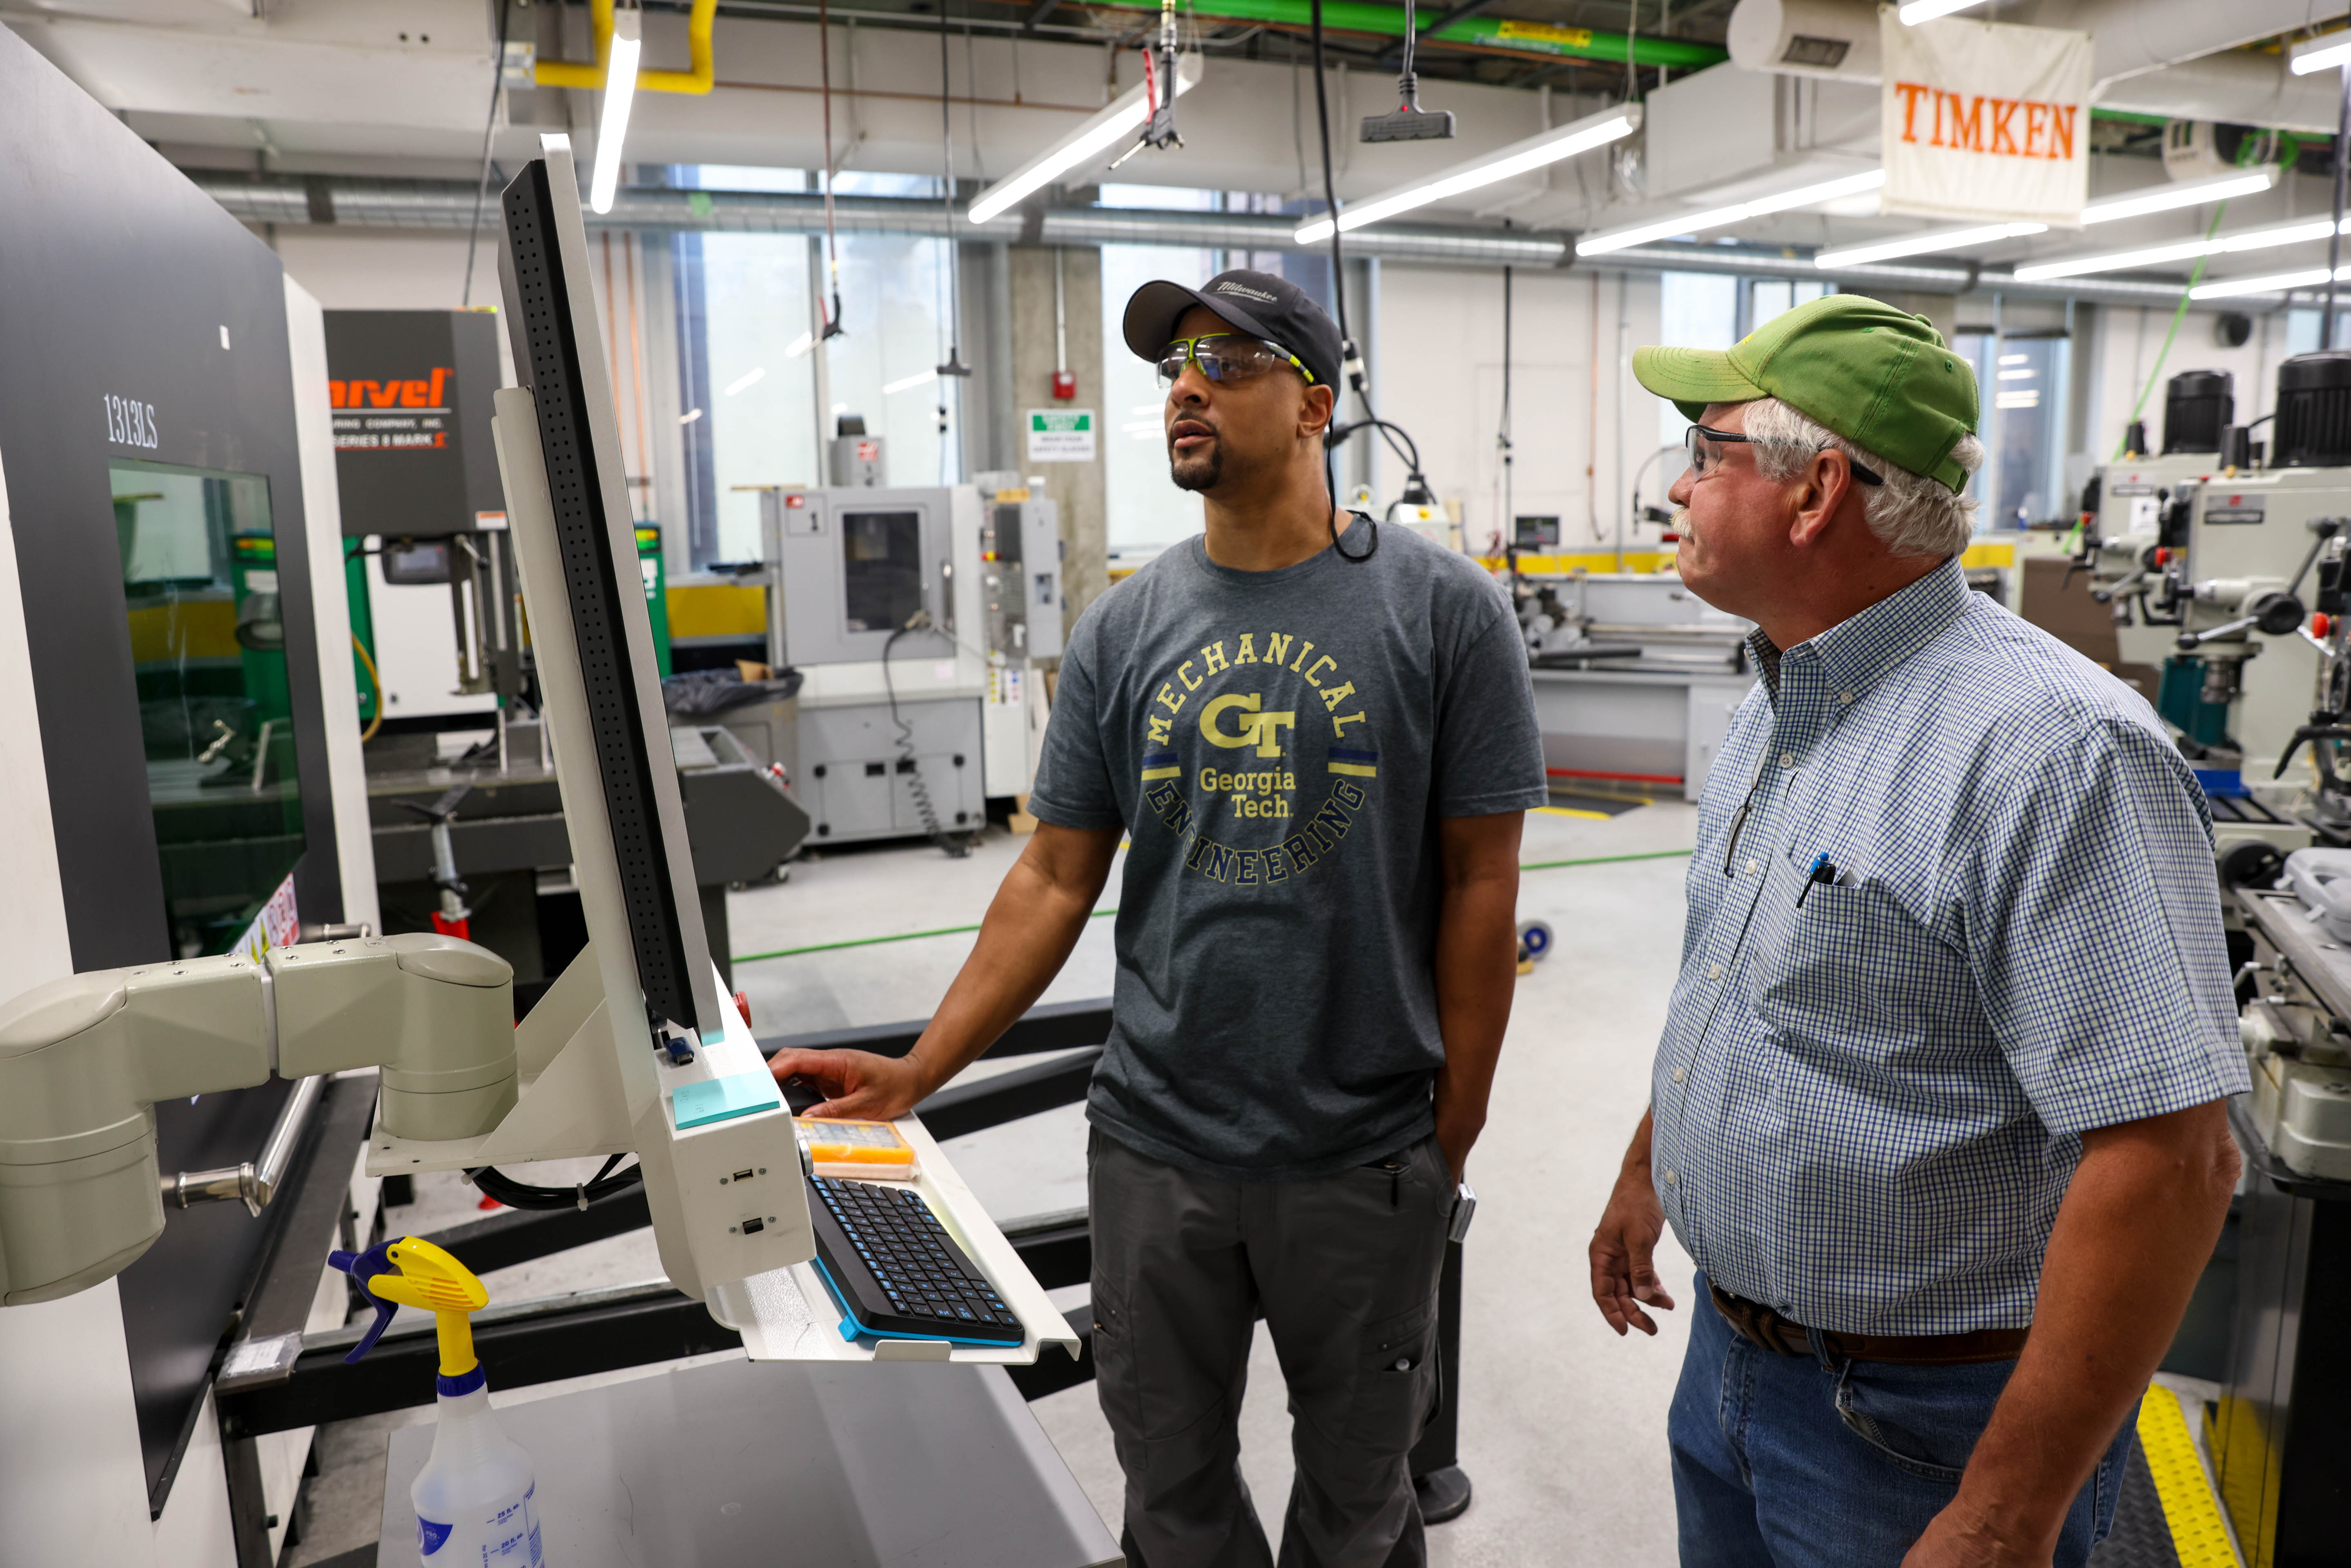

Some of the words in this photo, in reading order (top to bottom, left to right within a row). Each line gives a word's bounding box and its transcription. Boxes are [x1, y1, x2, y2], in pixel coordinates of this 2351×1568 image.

[1895, 81, 2077, 160] TIMKEN
[1217, 281, 1277, 302] Milwaukee
[104, 393, 158, 449] 1313LS
[392, 433, 433, 446] MARK
[1148, 632, 1366, 746] MECHANICAL
[1199, 693, 1295, 757] GT
[1200, 767, 1296, 795] Georgia
[1231, 794, 1289, 818] Tech
